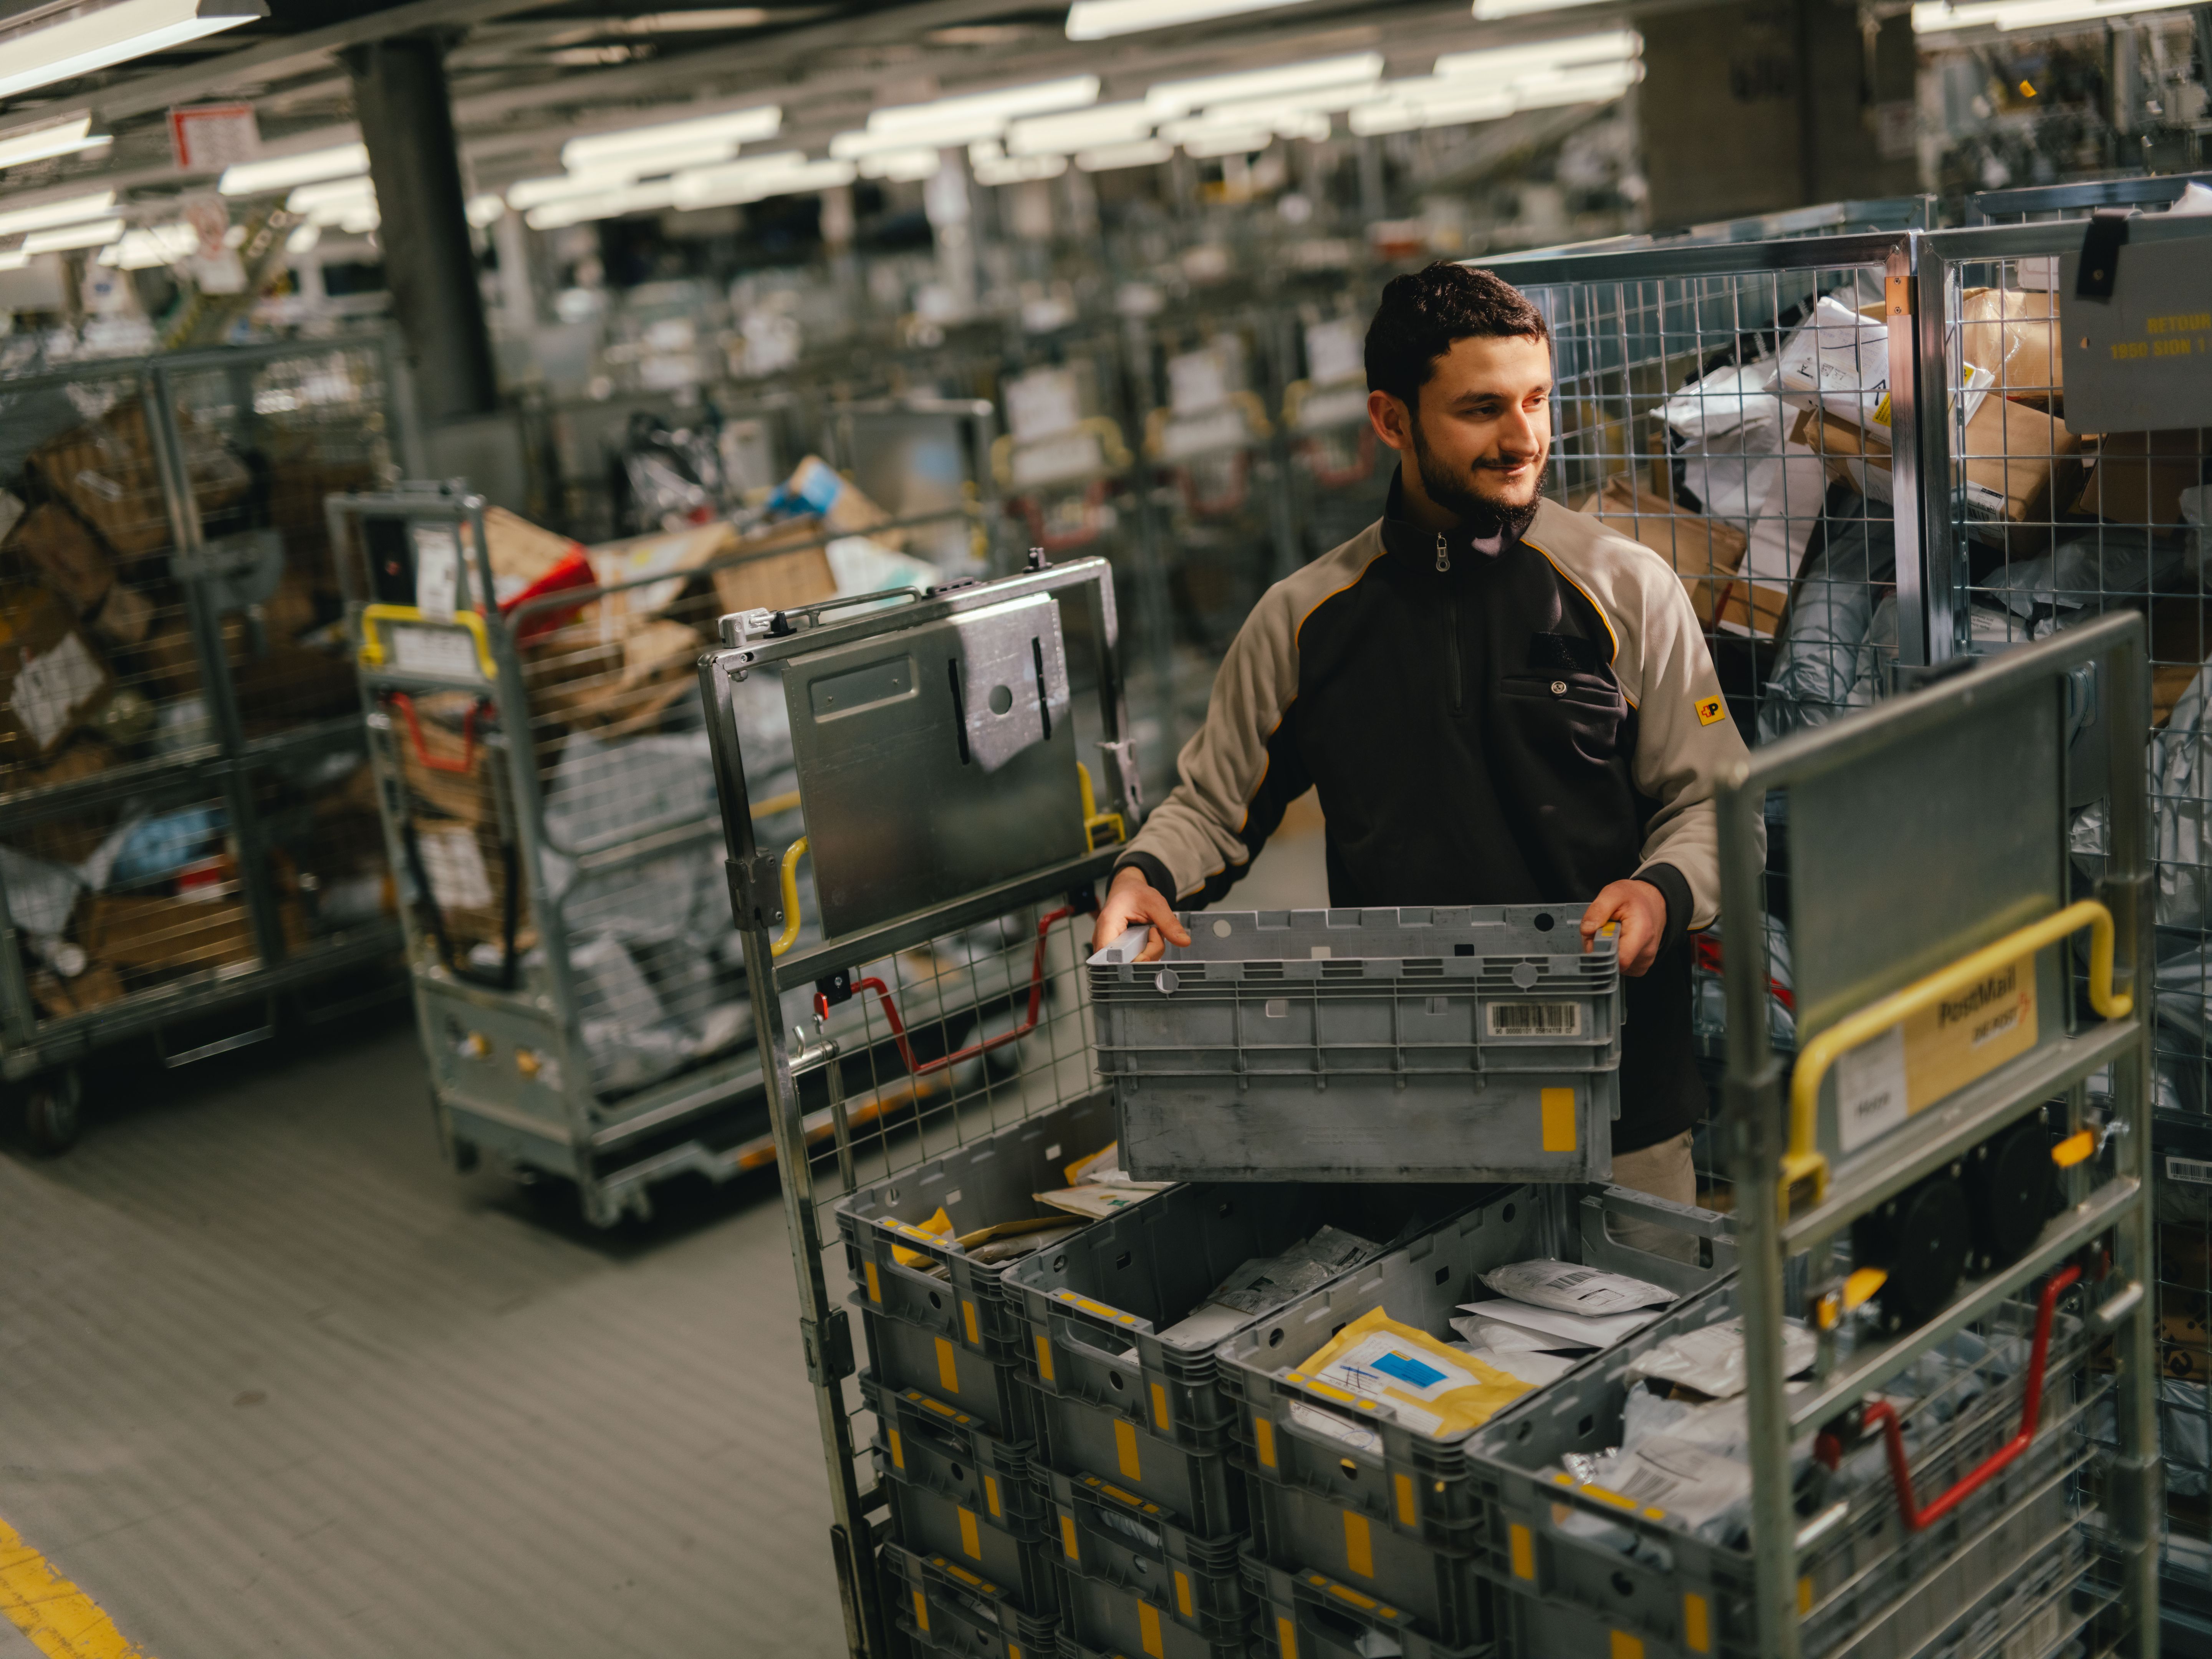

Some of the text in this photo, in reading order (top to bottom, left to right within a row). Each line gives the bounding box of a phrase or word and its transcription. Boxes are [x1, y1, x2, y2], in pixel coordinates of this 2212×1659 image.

[2147, 315, 2211, 333] RETOUR
[2154, 339, 2191, 356] SION
[1937, 965, 2016, 1028] PostMail
